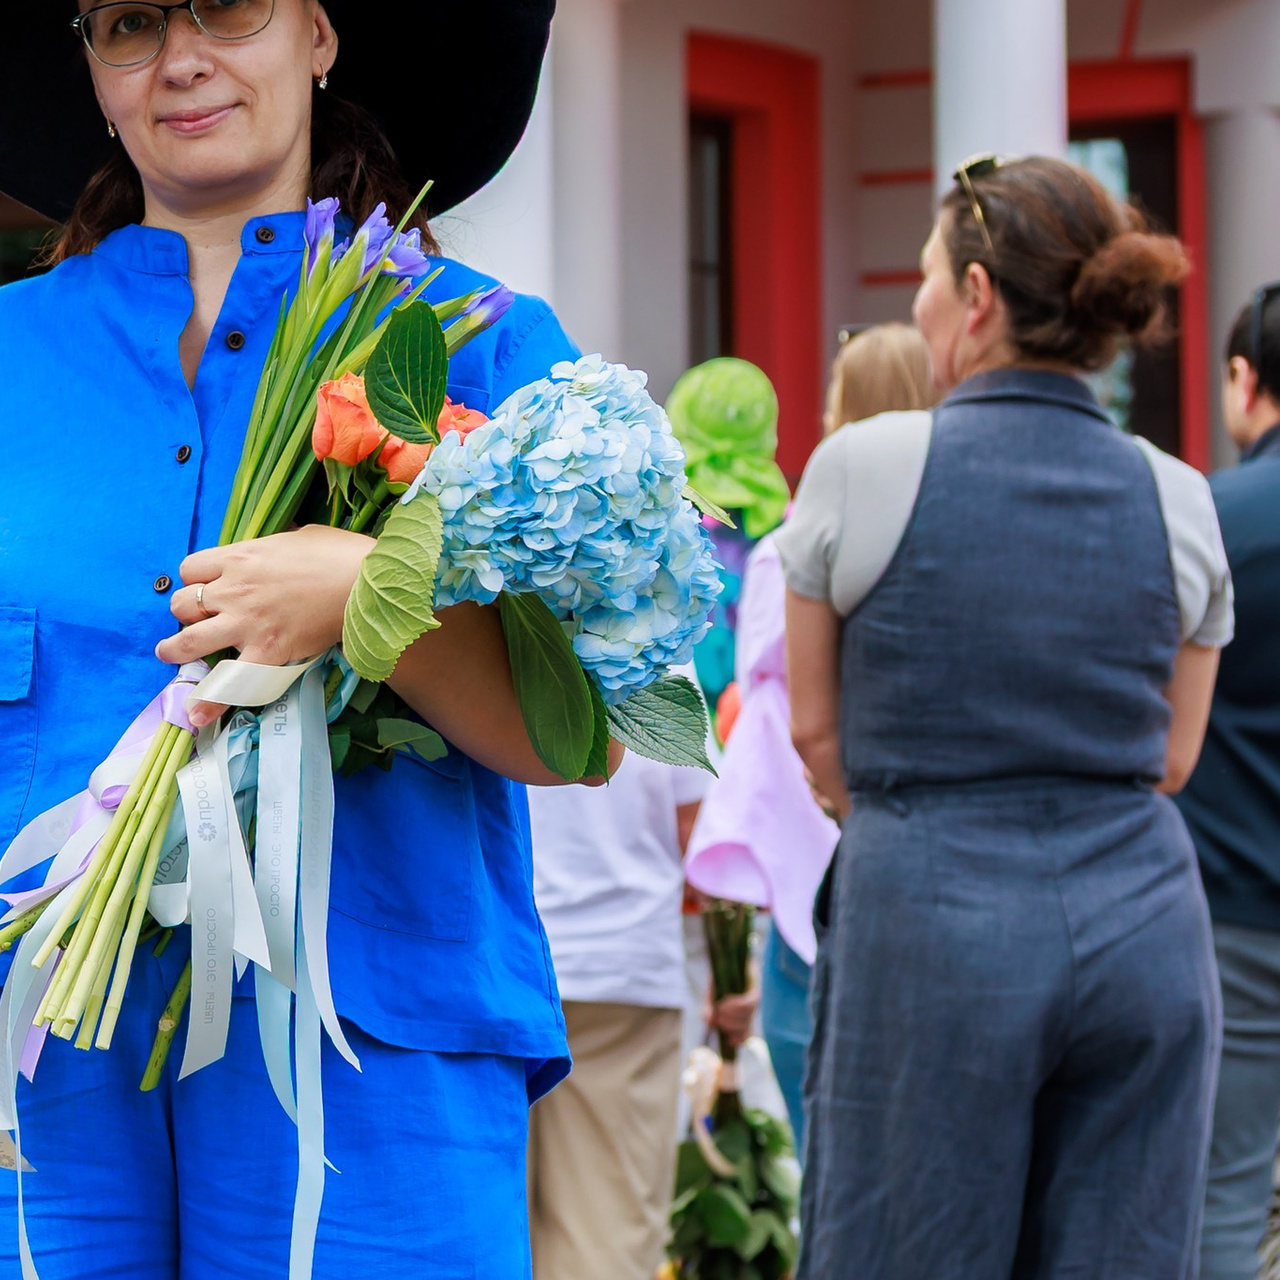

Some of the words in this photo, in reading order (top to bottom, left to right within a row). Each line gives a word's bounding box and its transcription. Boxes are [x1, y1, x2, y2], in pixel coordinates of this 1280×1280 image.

[272, 801, 283, 834] ЦВЕТЫ
[271, 844, 281, 867] ЭТО
[269, 870, 280, 917] ПРОСТО
[206, 908, 216, 956] ПРОСТО
[206, 959, 216, 982] ЭТО
[204, 991, 216, 1024] ЦВЕТЫ
